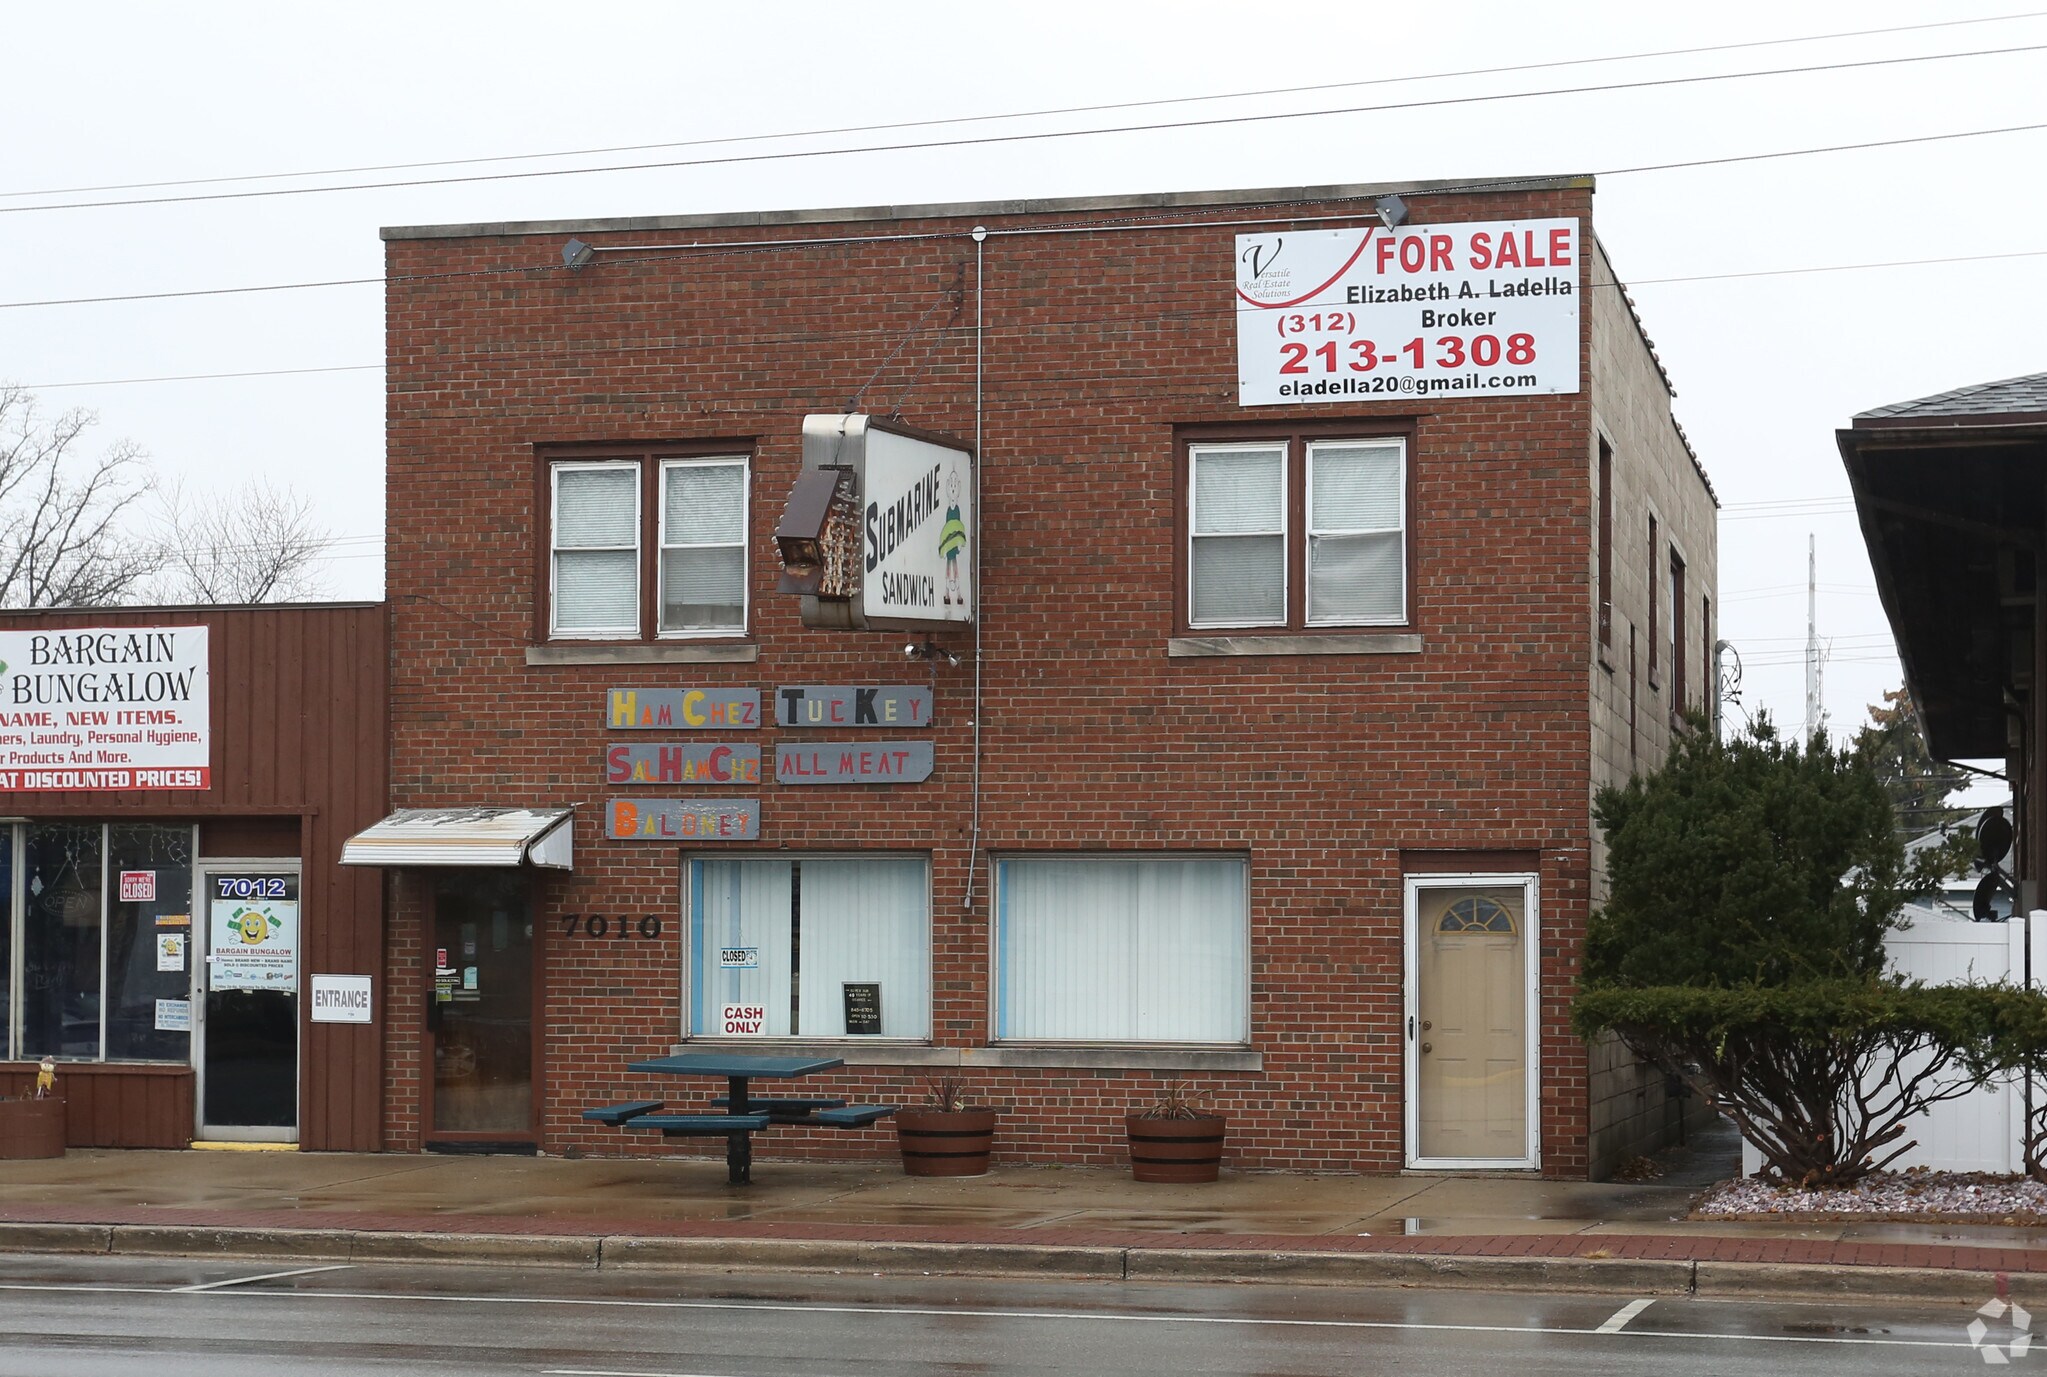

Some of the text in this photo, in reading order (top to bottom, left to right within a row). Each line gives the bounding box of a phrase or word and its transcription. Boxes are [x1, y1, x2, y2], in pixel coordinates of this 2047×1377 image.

[1242, 237, 1290, 280] Versatile
[1376, 228, 1571, 274] FOR SALE
[1243, 279, 1290, 290] Real Estate
[1253, 289, 1290, 299] Solutions
[1347, 277, 1572, 304] Elizabeth A. Ladella
[1277, 312, 1356, 338] (312)
[1422, 309, 1497, 328] Broker
[1279, 333, 1537, 374] 213-1308
[1279, 374, 1537, 396] eladella20@gmail.com
[866, 463, 940, 573] SUBMARINE
[882, 571, 935, 607] SANDWICH
[30, 633, 176, 666] BARGAIN
[12, 665, 197, 703] BUNGALOW
[612, 690, 755, 726] HAM CHEZ
[782, 689, 920, 724] TUCKEY
[66, 711, 109, 726] NEW
[117, 710, 182, 725] ITEMS.
[0, 729, 201, 747] ers, Laundry, Personal Hygiene,
[10, 751, 65, 764] Products
[69, 750, 93, 763] And
[97, 750, 131, 763] More.
[781, 751, 910, 776] ALL MEAT
[24, 771, 130, 788] DISCOUNTED
[136, 770, 201, 787] PRICES!
[613, 801, 750, 837] BALONEY
[123, 883, 152, 898] CLOSED
[218, 878, 286, 897] 7012
[45, 896, 88, 908] OPEN
[561, 914, 662, 939] 7010
[722, 950, 746, 962] CLOSED
[315, 990, 368, 1008] ENTRANCE
[724, 1007, 763, 1019] CASH
[725, 1021, 761, 1033] ONLY
